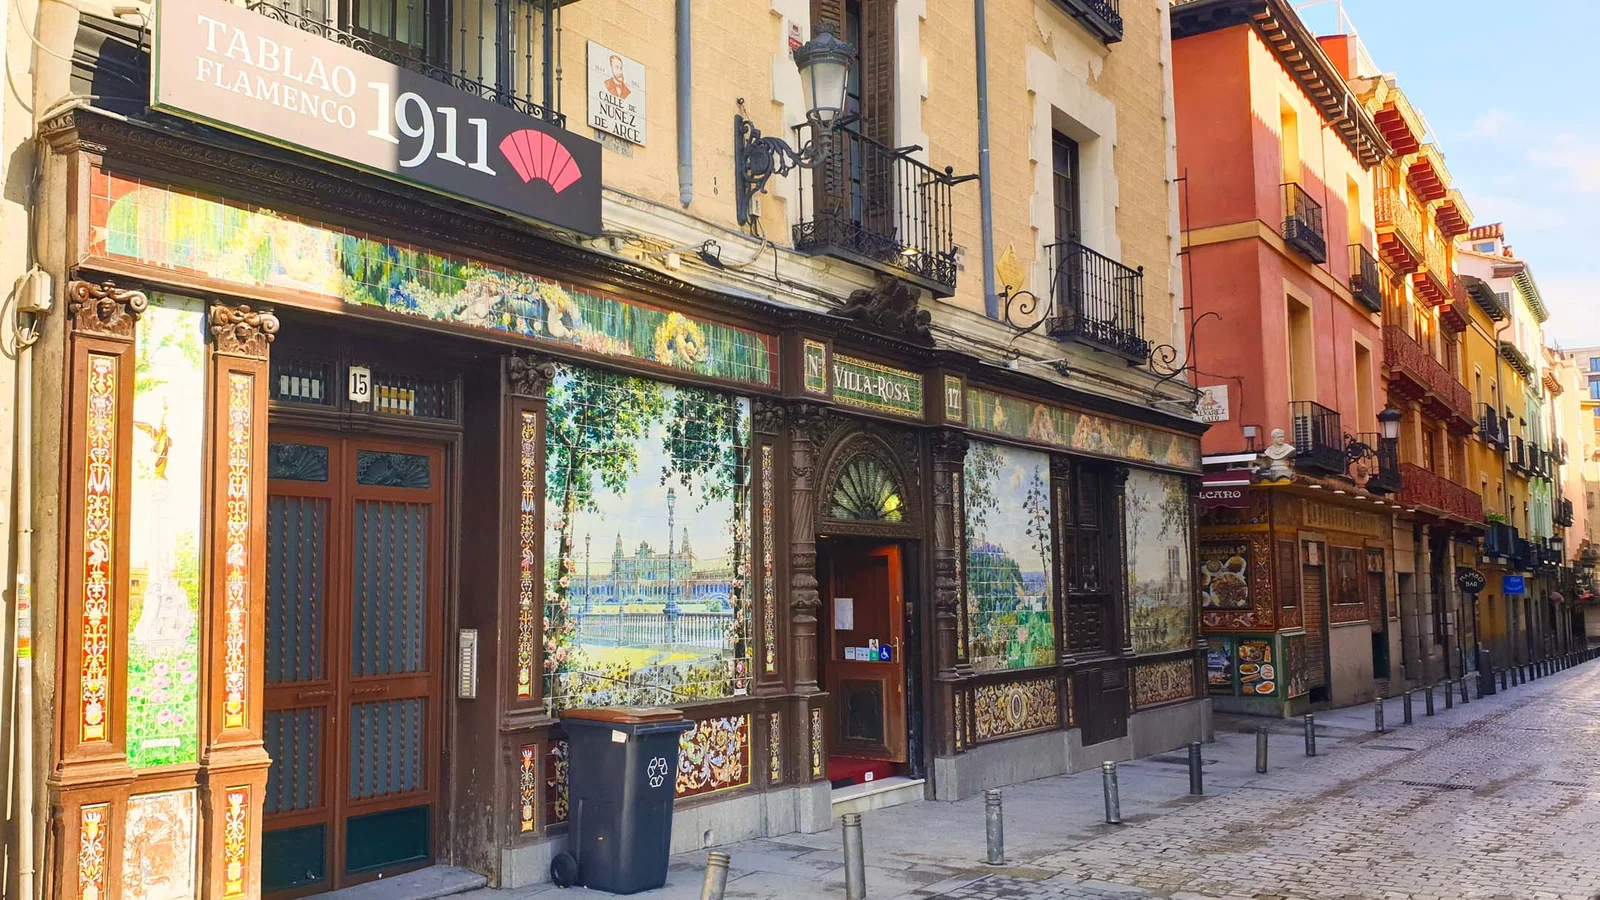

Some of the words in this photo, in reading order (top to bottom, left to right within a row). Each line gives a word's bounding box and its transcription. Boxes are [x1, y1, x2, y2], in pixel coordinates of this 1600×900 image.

[196, 13, 357, 98] TABLAO
[196, 55, 357, 129] FLAMENCO
[598, 90, 624, 109] CALLE
[628, 104, 637, 113] DE
[367, 82, 497, 177] 1911
[594, 115, 608, 129] DE
[613, 122, 642, 143] ARCE
[352, 372, 368, 395] 15
[948, 388, 959, 409] 17
[1459, 572, 1484, 583] MAMBO
